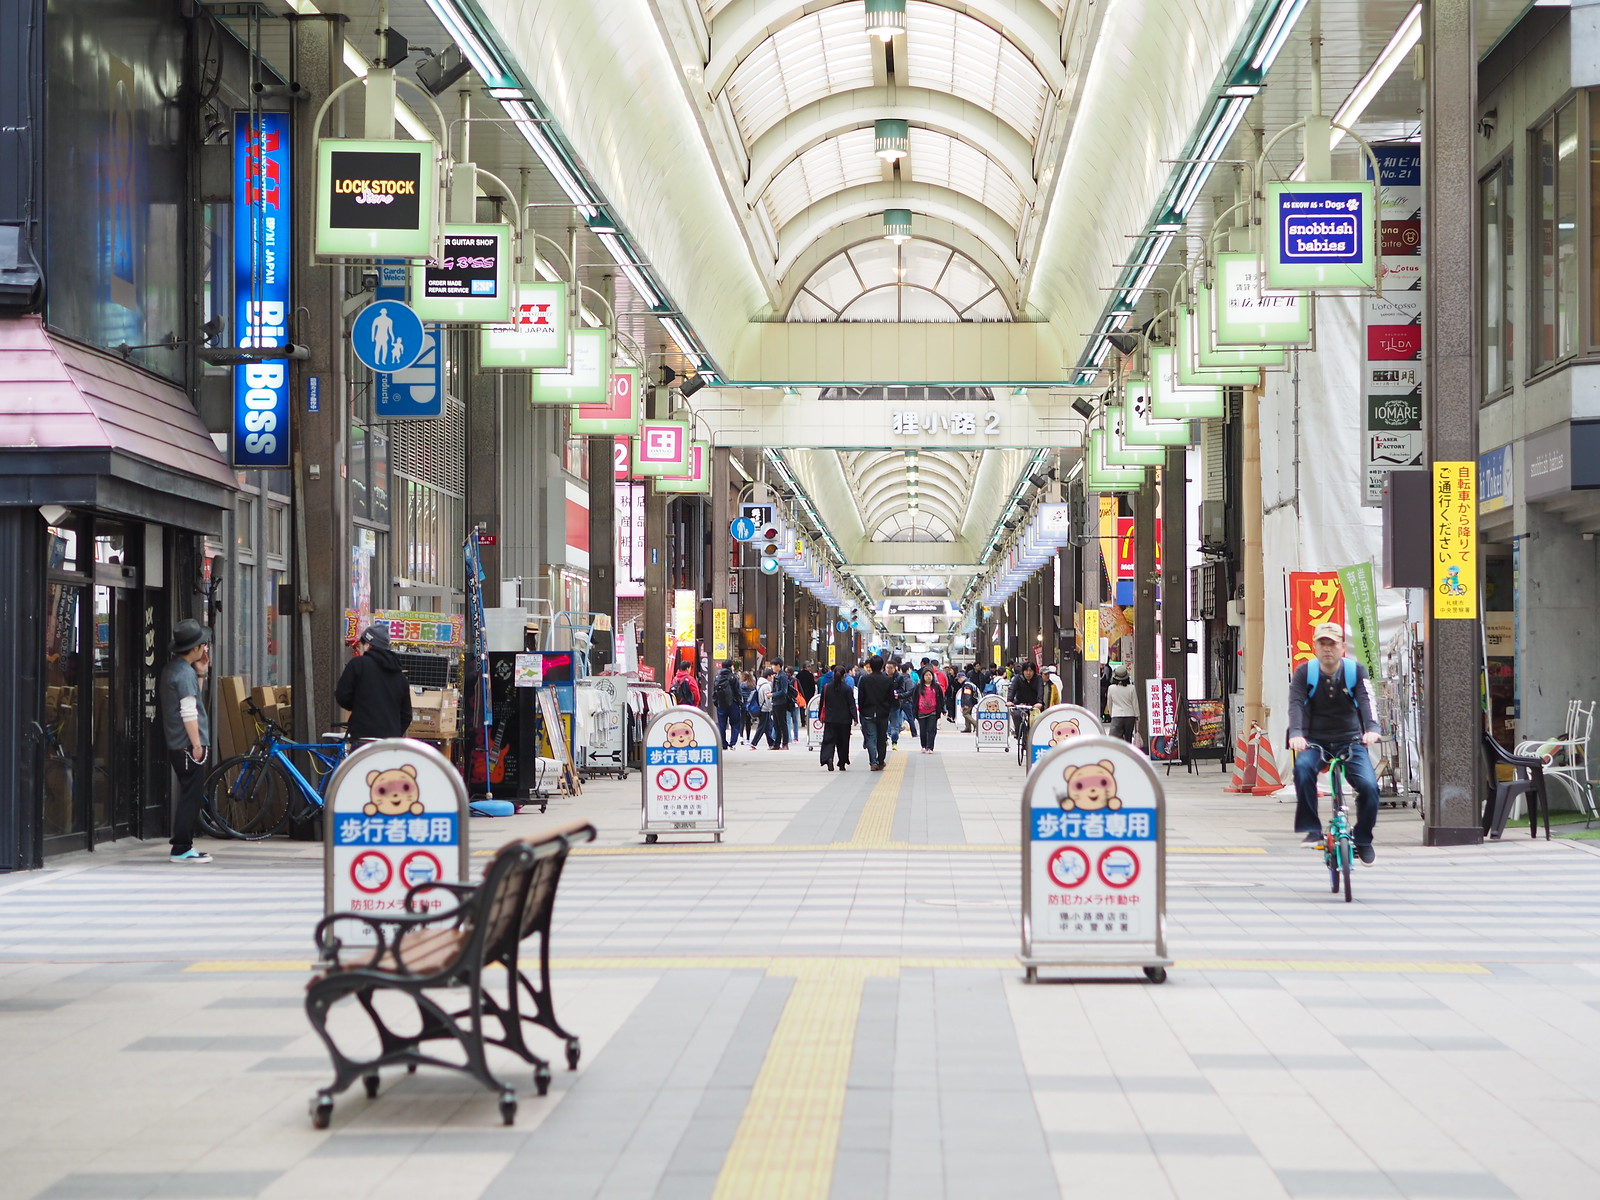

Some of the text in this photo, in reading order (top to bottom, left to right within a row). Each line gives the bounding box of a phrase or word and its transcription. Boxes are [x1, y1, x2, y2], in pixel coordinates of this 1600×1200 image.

[1399, 170, 1412, 178] 21
[335, 179, 415, 195] LOCK STOCK
[355, 187, 394, 204] Store
[1325, 200, 1346, 211] Dogs
[1289, 222, 1354, 235] snobbish
[451, 238, 475, 246] GUITAR
[475, 238, 494, 246] SHOP
[1296, 238, 1346, 252] babies
[265, 249, 276, 284] JAPAN
[383, 267, 406, 275] Cards
[1389, 264, 1420, 274] Lotus
[472, 281, 493, 292] ESP
[1380, 337, 1412, 352] TILDA
[244, 364, 285, 454] BOSS
[1374, 406, 1418, 419] IOMARE
[892, 411, 1001, 435] 狸小路 2
[1438, 467, 1452, 563] ご通行ください
[1457, 466, 1471, 562] 自転車から降りて
[650, 748, 713, 764] 歩行者専用
[340, 817, 452, 844] 歩行者専用
[1037, 812, 1150, 839] 歩行者専用
[1047, 893, 1140, 906] 防犯カメラ作動中
[1059, 923, 1129, 932] 中央警察署
